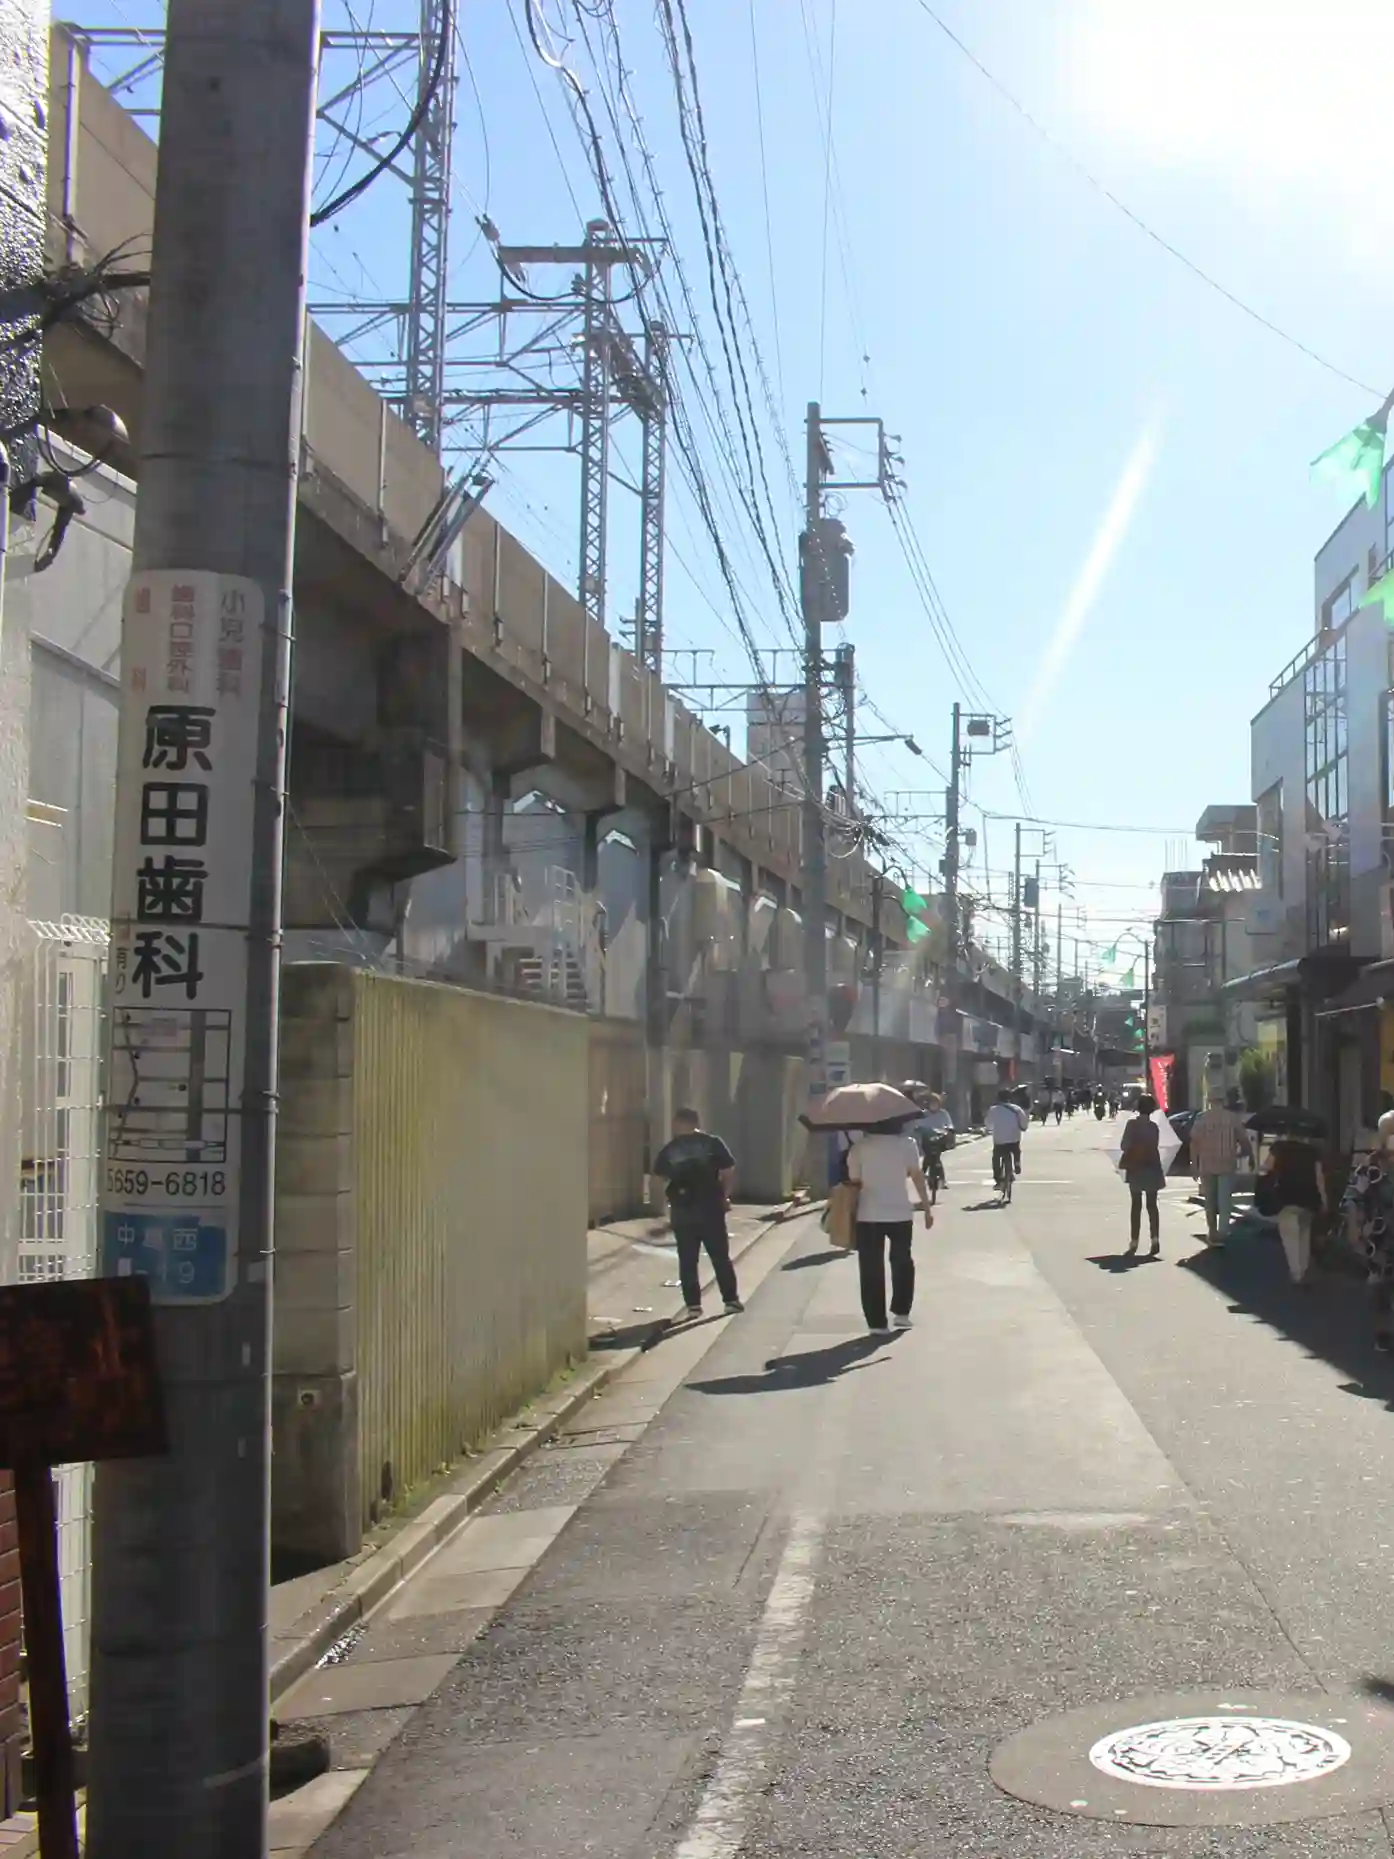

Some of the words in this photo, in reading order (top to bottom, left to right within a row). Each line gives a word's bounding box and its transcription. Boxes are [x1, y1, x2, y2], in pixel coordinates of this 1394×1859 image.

[132, 704, 217, 1000] 原田歯科
[117, 1221, 198, 1252] 中西
